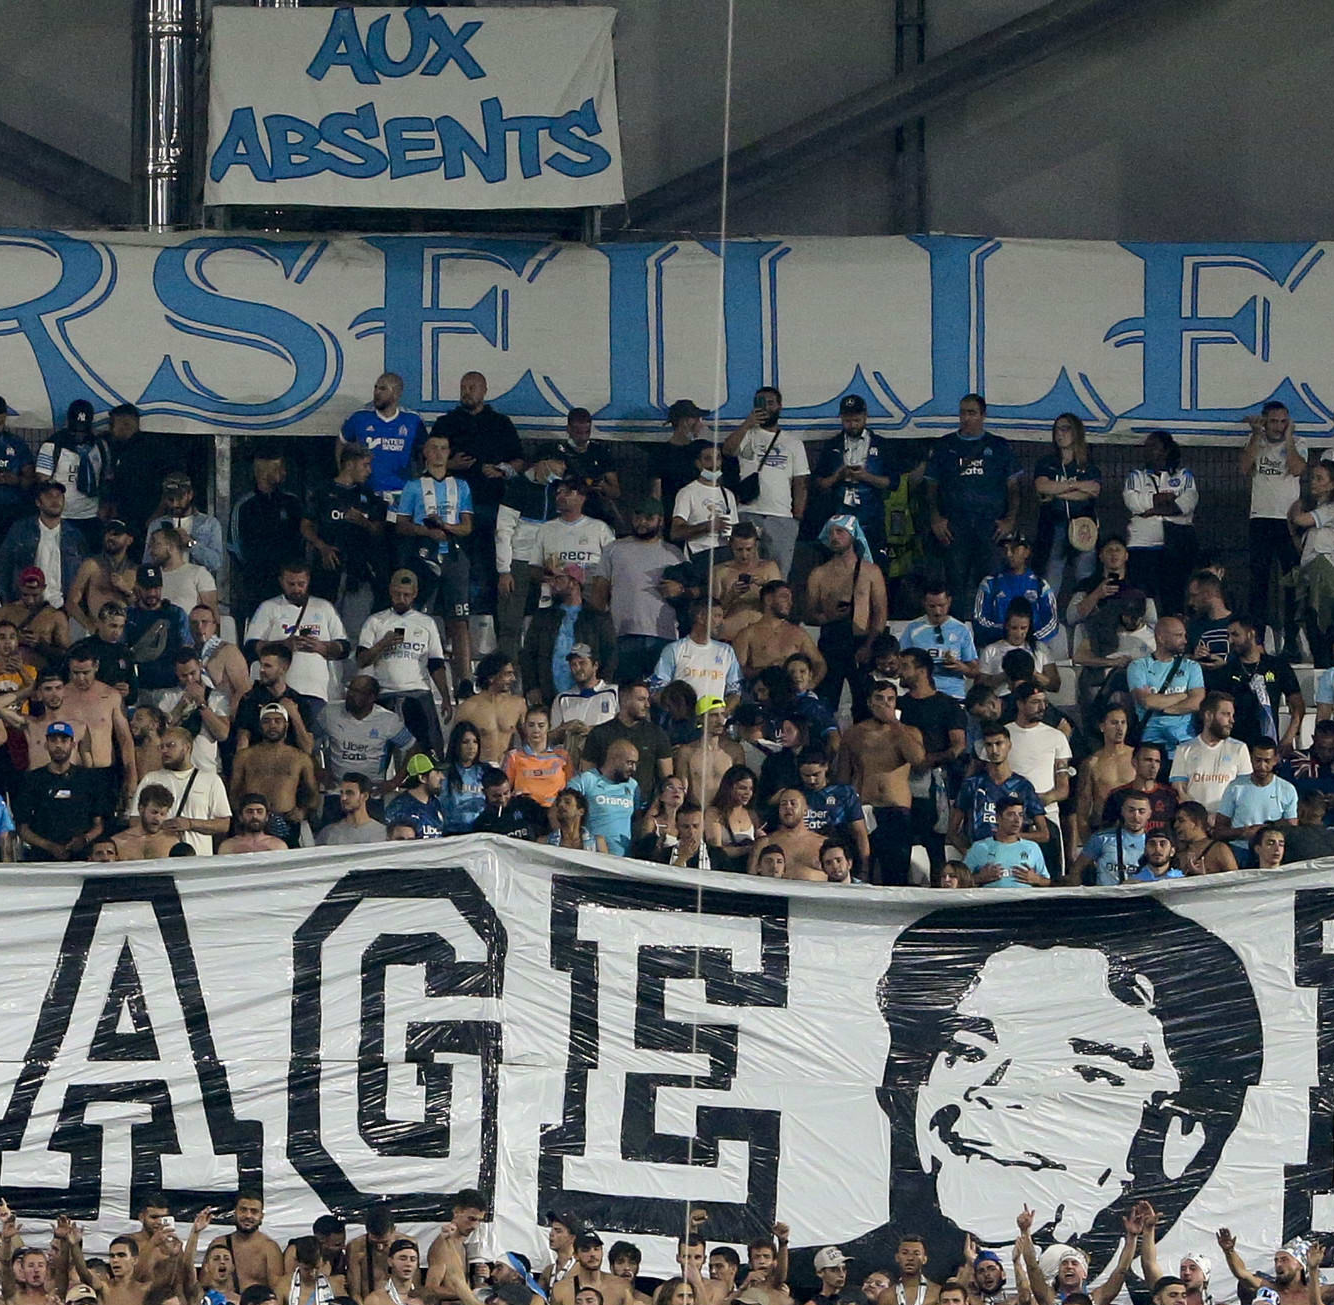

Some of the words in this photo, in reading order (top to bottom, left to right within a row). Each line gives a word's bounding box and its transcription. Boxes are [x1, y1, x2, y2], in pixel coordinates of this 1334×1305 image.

[306, 6, 487, 85] AUX
[210, 97, 612, 184] ABSENTS
[381, 437, 405, 446] INTER
[342, 741, 368, 751] Uber
[342, 751, 367, 761] Eats
